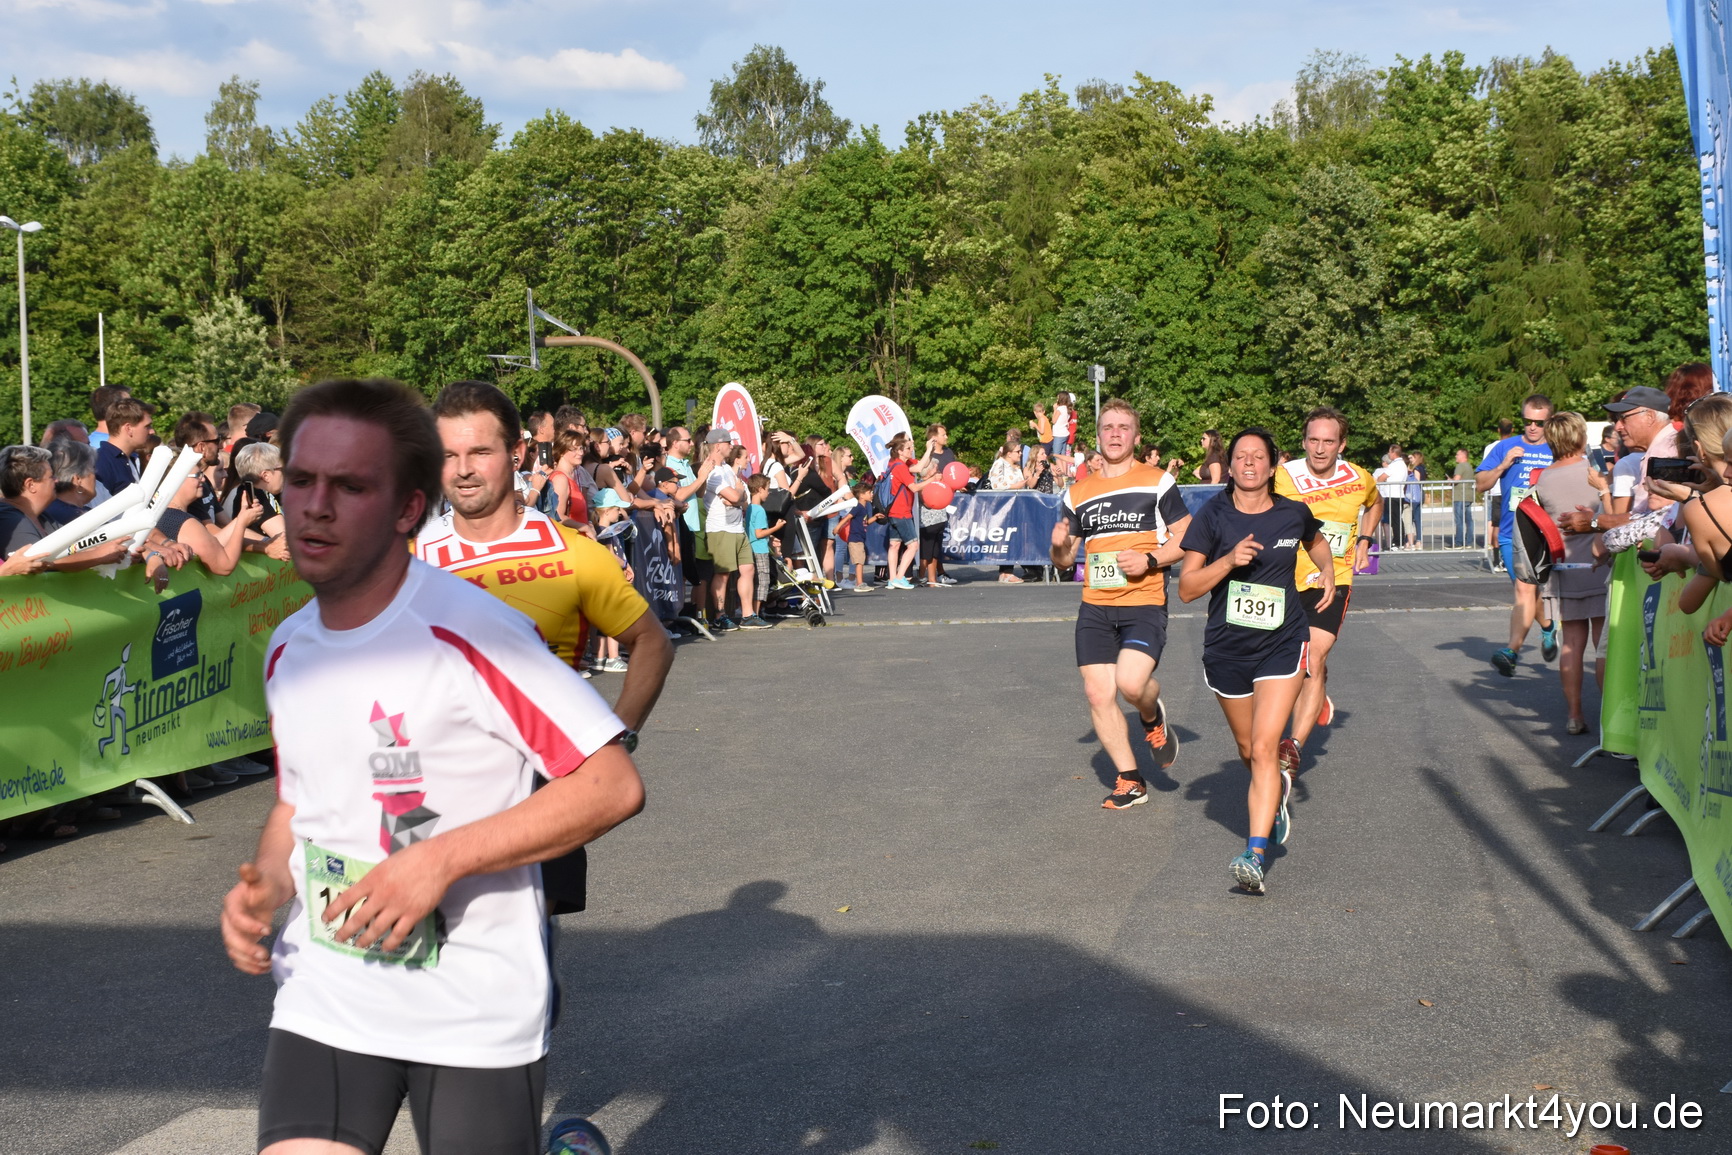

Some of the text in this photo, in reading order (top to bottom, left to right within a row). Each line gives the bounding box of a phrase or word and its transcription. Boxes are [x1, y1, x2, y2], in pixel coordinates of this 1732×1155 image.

[1302, 483, 1365, 505] MAX BÖGL
[1089, 509, 1146, 527] Fischer
[942, 522, 1018, 542] scher
[942, 545, 1009, 554] TOMOBILE
[497, 560, 574, 586] BÖGL
[1094, 564, 1115, 579] 739
[1234, 597, 1275, 618] 1391
[134, 642, 236, 727] firmenlauf
[136, 713, 181, 747] neumarkt
